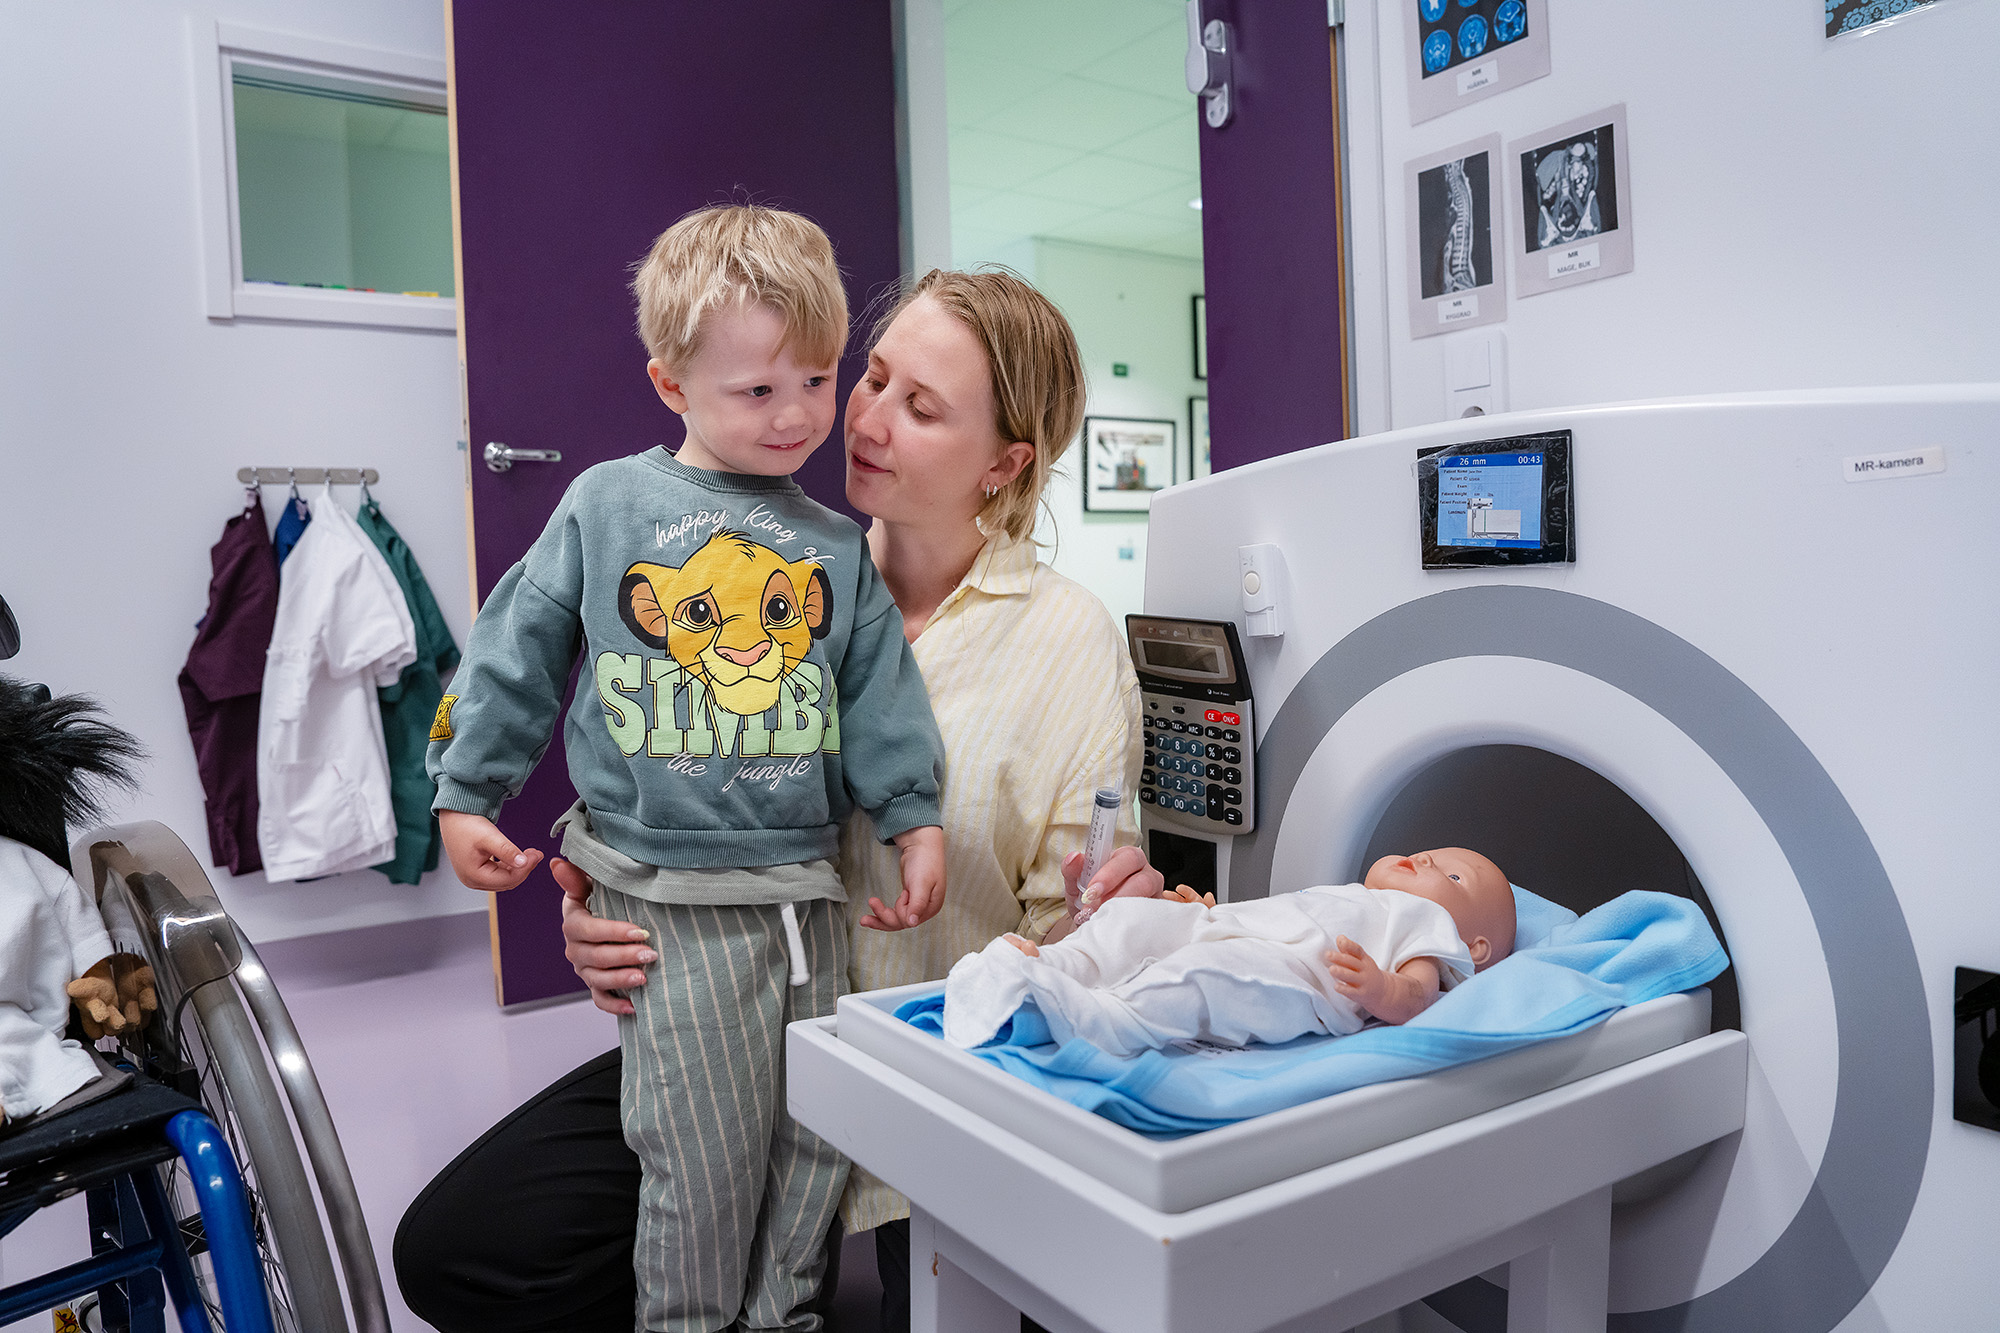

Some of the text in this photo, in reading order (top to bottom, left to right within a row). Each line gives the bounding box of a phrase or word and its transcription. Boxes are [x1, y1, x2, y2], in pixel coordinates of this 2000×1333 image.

[1460, 457, 1470, 466] 26
[1518, 455, 1541, 464] 00:43
[1854, 456, 1924, 472] MR-kamera
[656, 503, 836, 566] happy King of
[1159, 738, 1164, 746] 7
[1175, 741, 1180, 750] 8
[1191, 744, 1196, 753] 9
[666, 750, 812, 793] the jungle
[1160, 758, 1164, 766] 4
[1176, 761, 1180, 770] 5
[1192, 764, 1197, 773] 6
[1176, 780, 1181, 790] 2
[1192, 784, 1197, 793] 3
[1160, 796, 1165, 805] 0
[1175, 799, 1184, 809] 00
